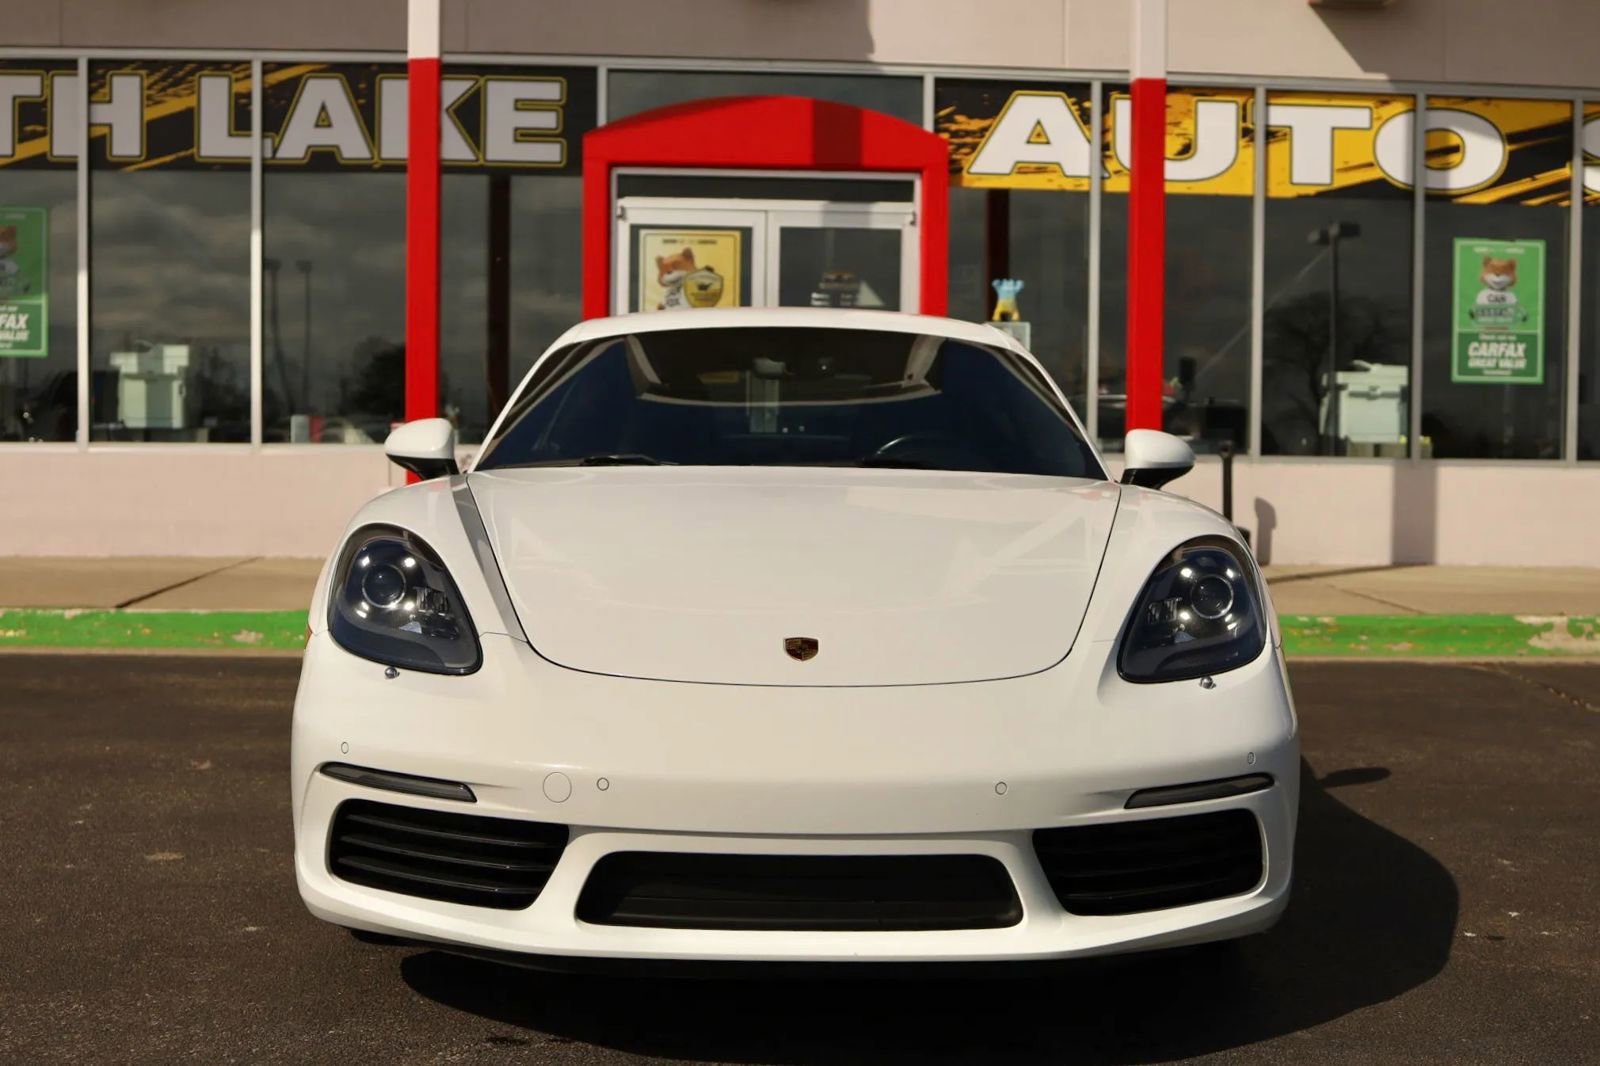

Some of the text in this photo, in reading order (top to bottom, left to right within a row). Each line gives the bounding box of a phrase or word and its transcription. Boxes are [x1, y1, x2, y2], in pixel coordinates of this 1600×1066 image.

[197, 73, 565, 165] LAKE
[965, 92, 1507, 193] AUTO
[1467, 341, 1527, 358] CARFAX
